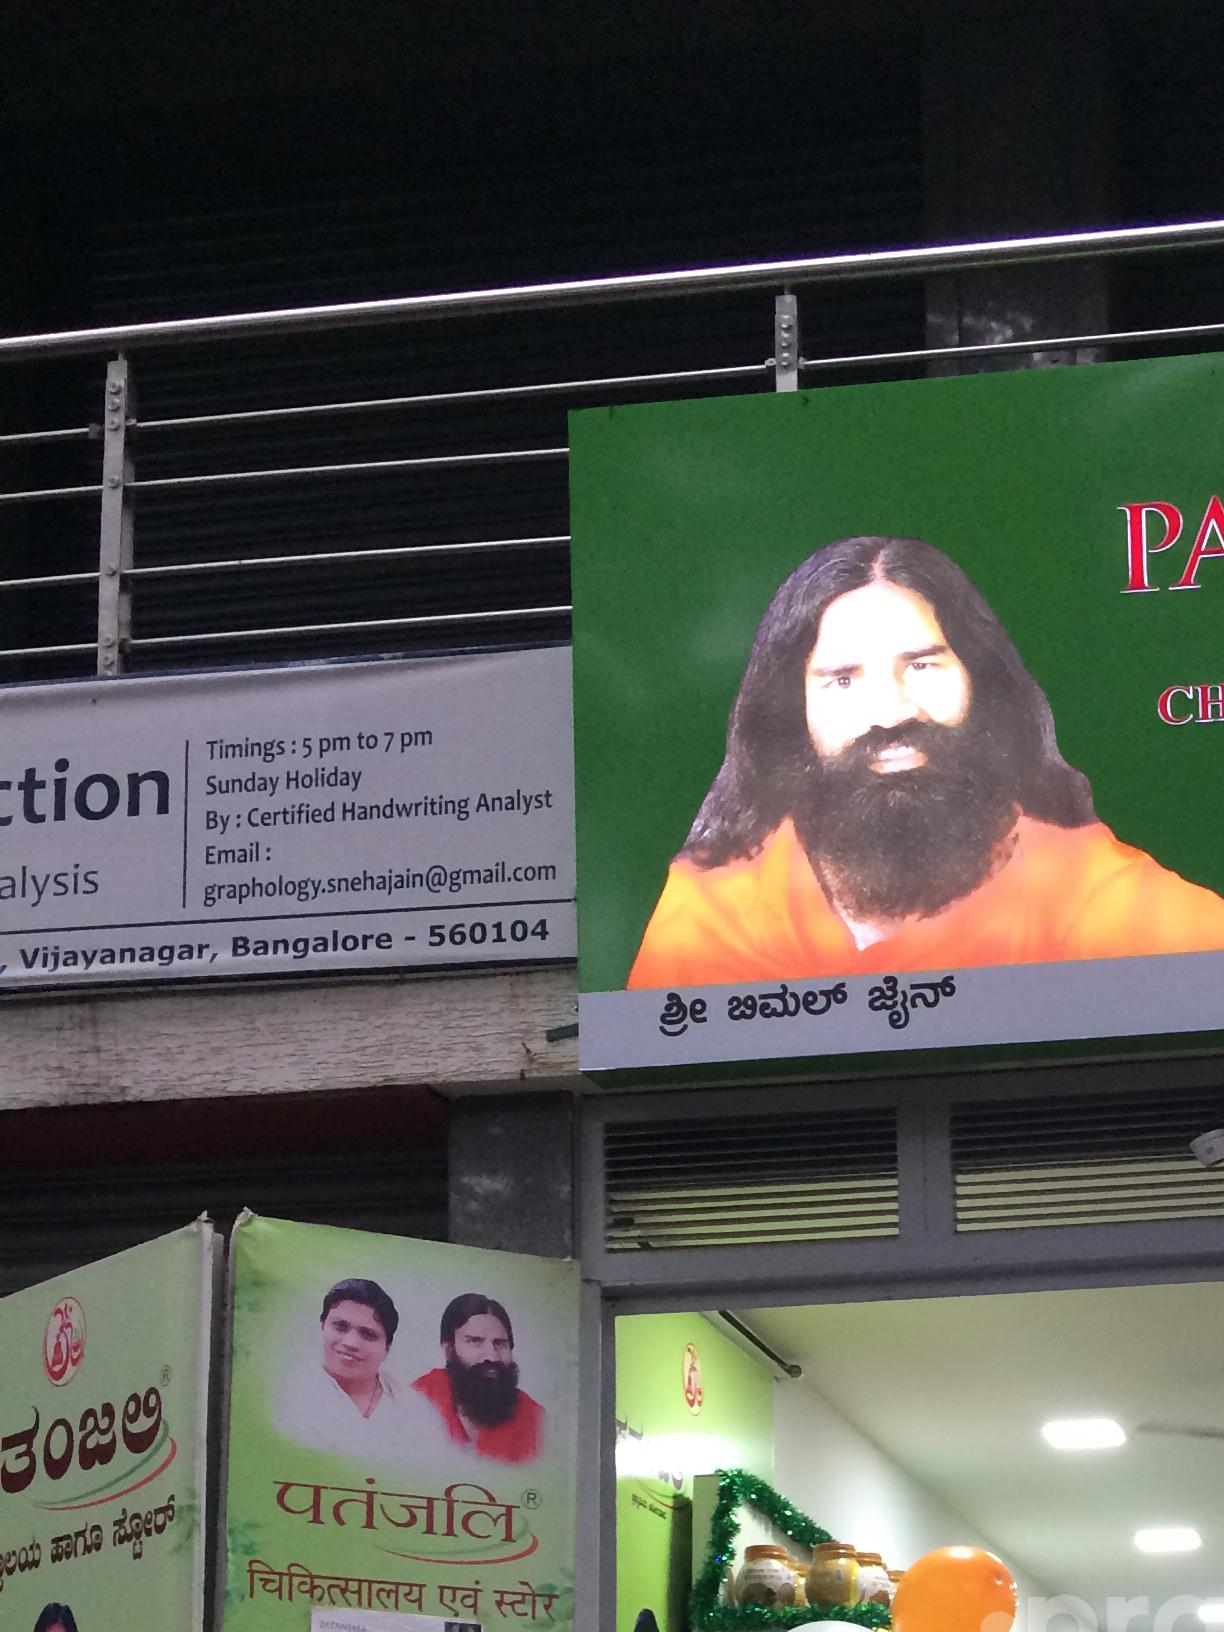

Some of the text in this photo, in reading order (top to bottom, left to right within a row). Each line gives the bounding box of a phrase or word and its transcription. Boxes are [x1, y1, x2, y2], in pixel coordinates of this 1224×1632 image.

[207, 737, 285, 763] Timings
[302, 736, 312, 758] 5
[319, 736, 351, 759] pm
[357, 732, 378, 752] to
[383, 732, 394, 753] 7
[400, 729, 433, 751] pm
[206, 767, 362, 799] Sunday Holiday
[206, 809, 231, 832] By
[247, 801, 335, 827] Certified
[341, 795, 470, 822] Handwriting
[476, 790, 553, 816] Analyst
[205, 844, 260, 865] Email
[203, 860, 557, 907] graphology.snehajain@gmail.com
[20, 939, 219, 972] Vijayanagar,
[231, 930, 392, 959] Bangalore
[428, 919, 549, 947] 560104
[659, 975, 956, 1037] ಶ್ರೀ ಬಿಮಲ್ ಜೈನ್
[273, 1478, 520, 1543] पतंजलि
[51, 1520, 103, 1564] ಹಾಗೂ
[247, 1559, 560, 1621] चिकित्सालय एवं स्टोर
